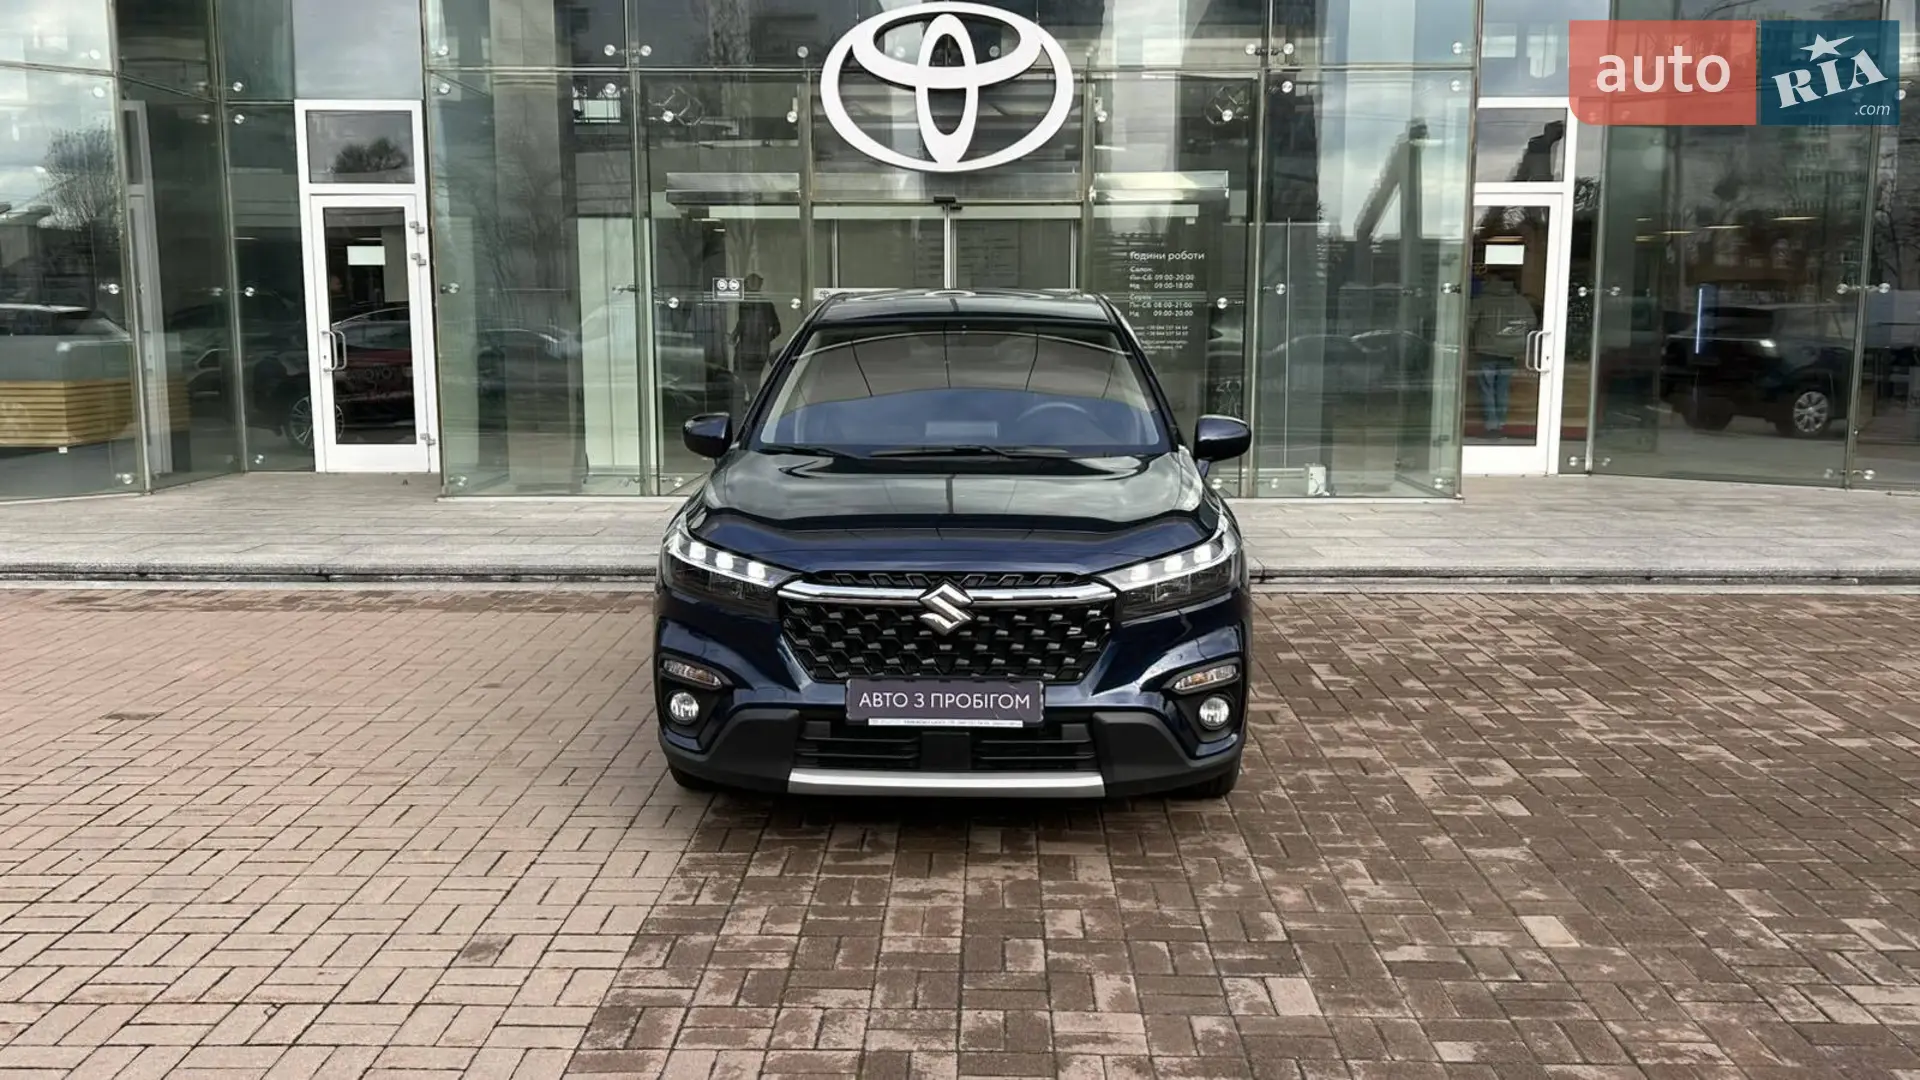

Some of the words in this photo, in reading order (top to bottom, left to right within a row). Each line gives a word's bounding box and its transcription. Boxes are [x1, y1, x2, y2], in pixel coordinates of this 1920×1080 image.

[1129, 251, 1166, 261] Години
[1168, 250, 1205, 262] роботи
[859, 692, 908, 708] АВТО
[913, 693, 925, 708] З
[930, 692, 1030, 709] ПРОБІГОМ
